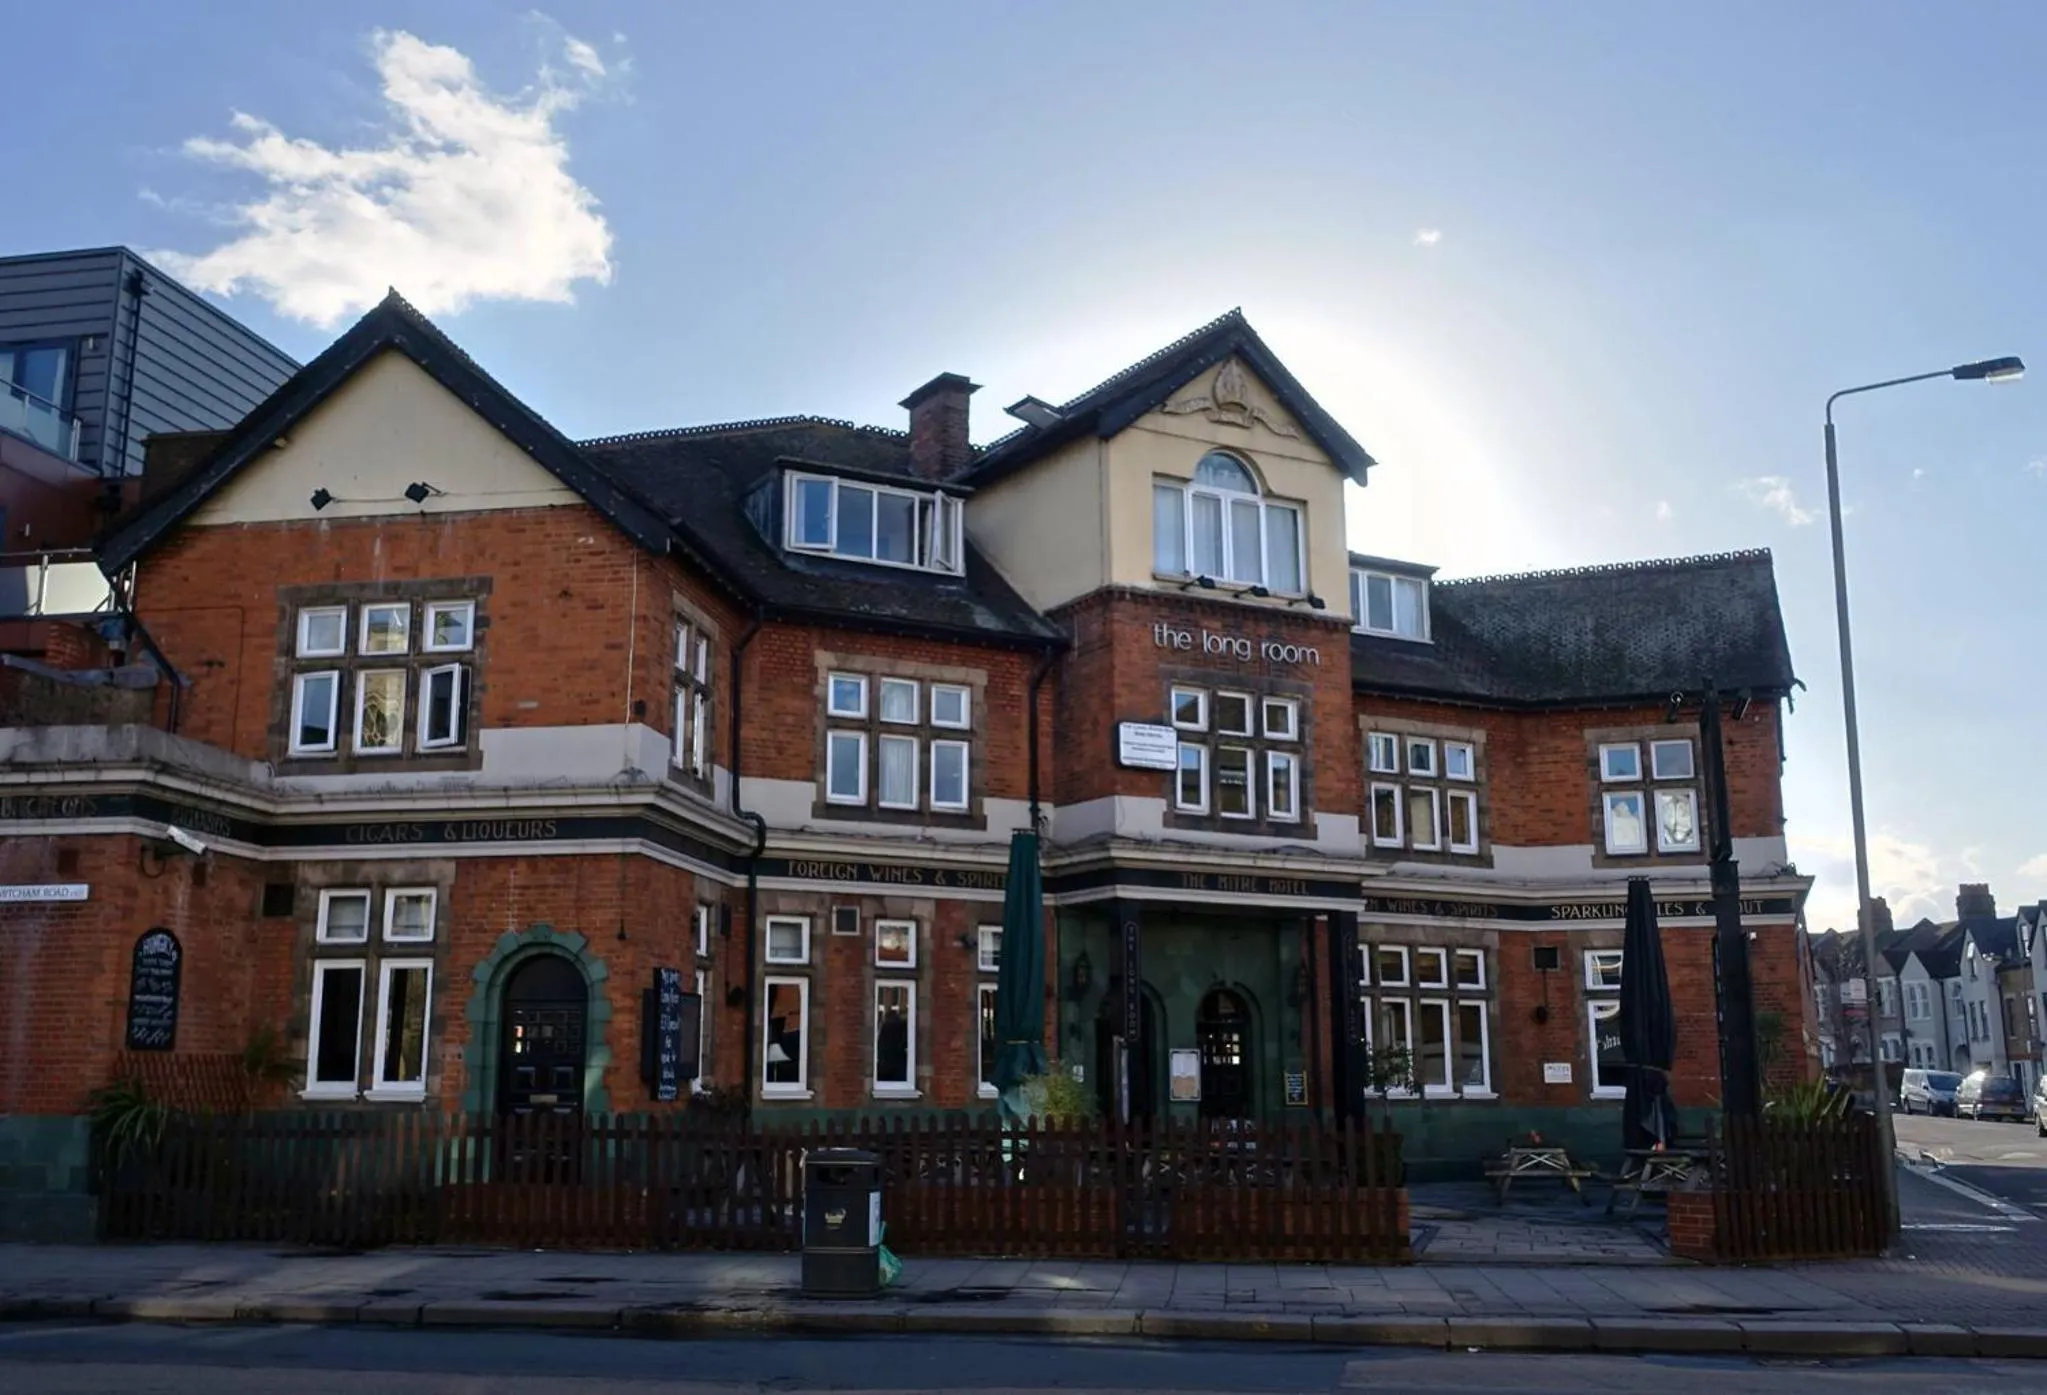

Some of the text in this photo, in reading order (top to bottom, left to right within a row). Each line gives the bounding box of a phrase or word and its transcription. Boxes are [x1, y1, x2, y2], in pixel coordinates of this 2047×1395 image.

[1153, 623, 1321, 667] the long room
[0, 797, 98, 817] UNCHEONS
[345, 819, 557, 842] CIGARS & LIQUEURS
[788, 861, 1006, 889] FOREIGN WINES & SPIRIT
[1181, 873, 1208, 889] THE
[43, 886, 70, 898] ROAD
[1386, 898, 1428, 914] WINES
[1449, 903, 1498, 918] SPIRITS
[1657, 902, 1685, 916] LES
[1695, 901, 1706, 916] &
[1739, 900, 1765, 914] OUT
